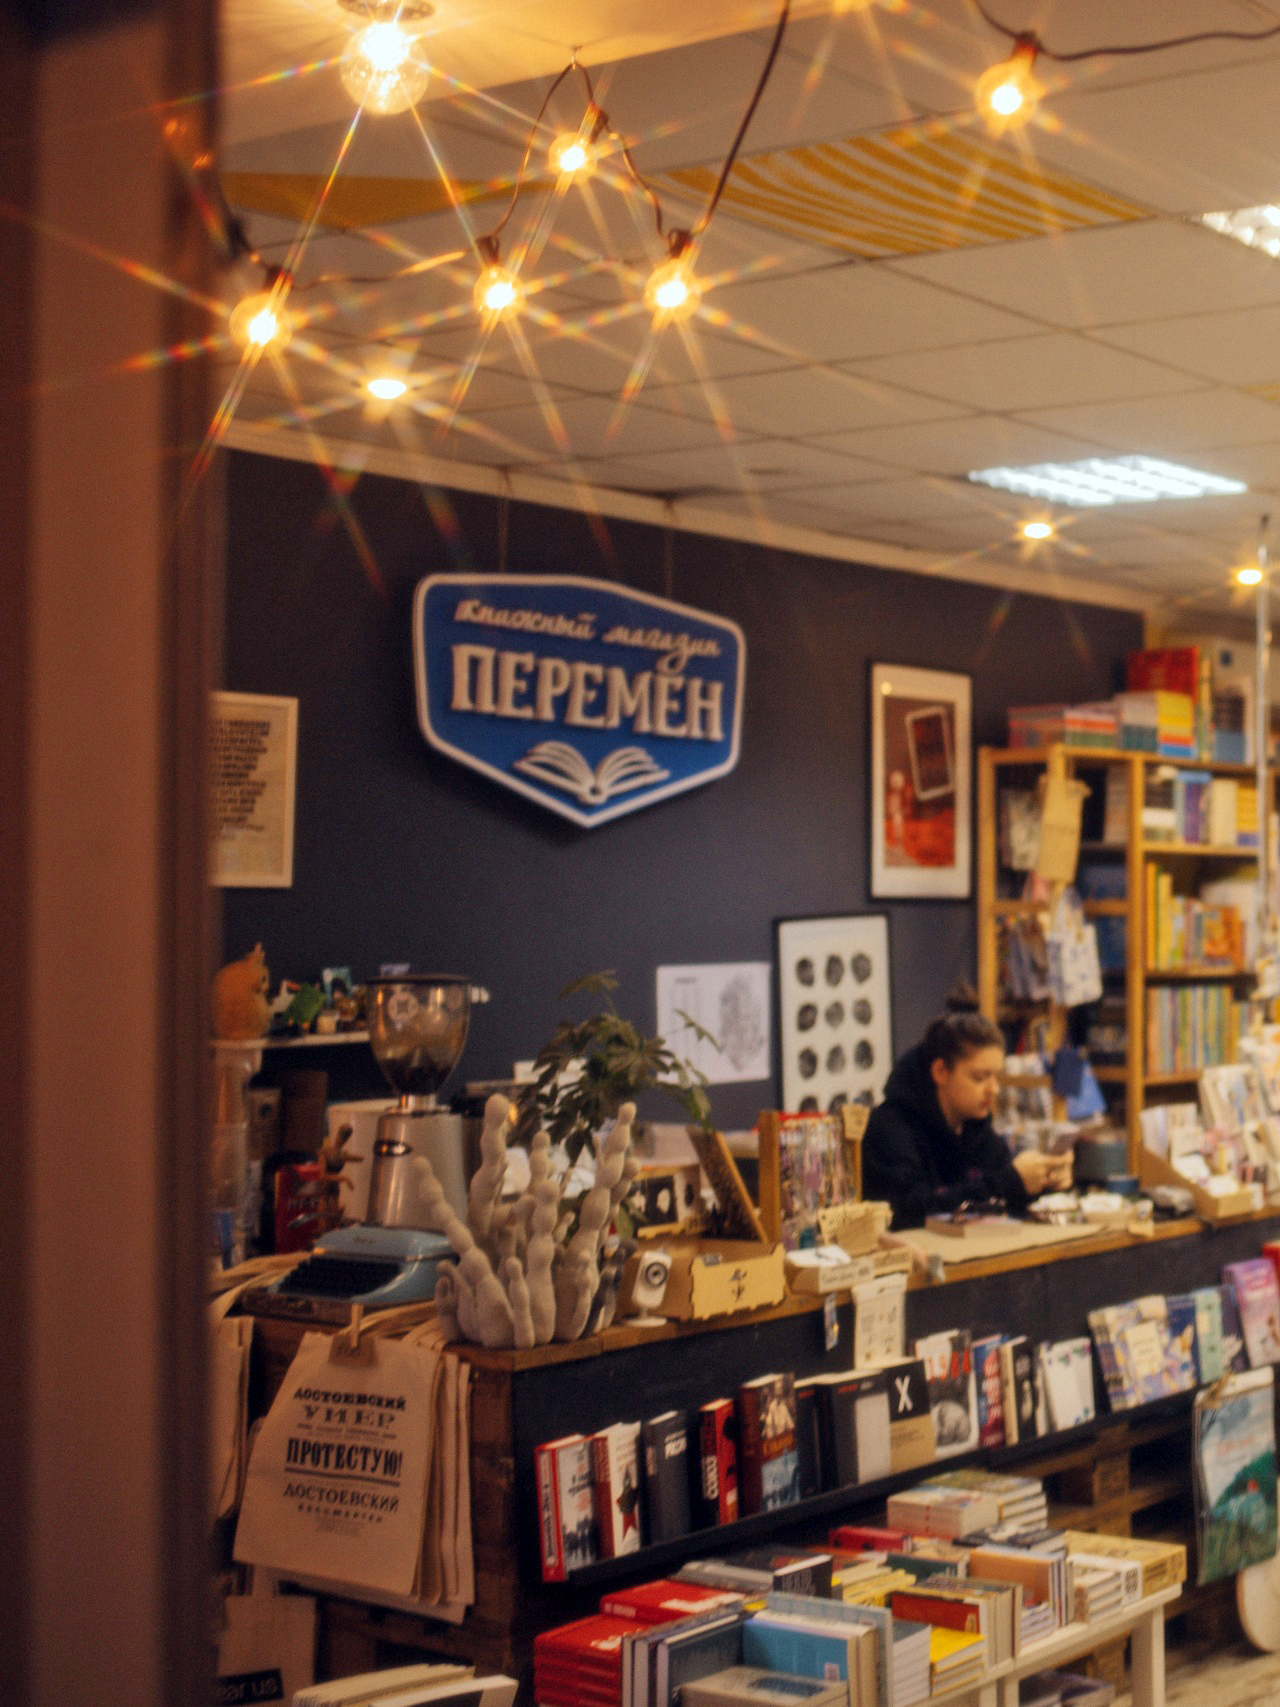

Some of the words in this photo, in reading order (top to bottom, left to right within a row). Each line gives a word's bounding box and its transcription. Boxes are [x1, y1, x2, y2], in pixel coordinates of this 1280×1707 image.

[453, 599, 597, 641] Книжный
[602, 625, 721, 675] магазин
[451, 644, 724, 741] ПЕРЕМЕН
[286, 1437, 403, 1478] ПРОТЕСТУЮ!
[283, 1482, 399, 1514] ДОСТОЕВСКИЙ
